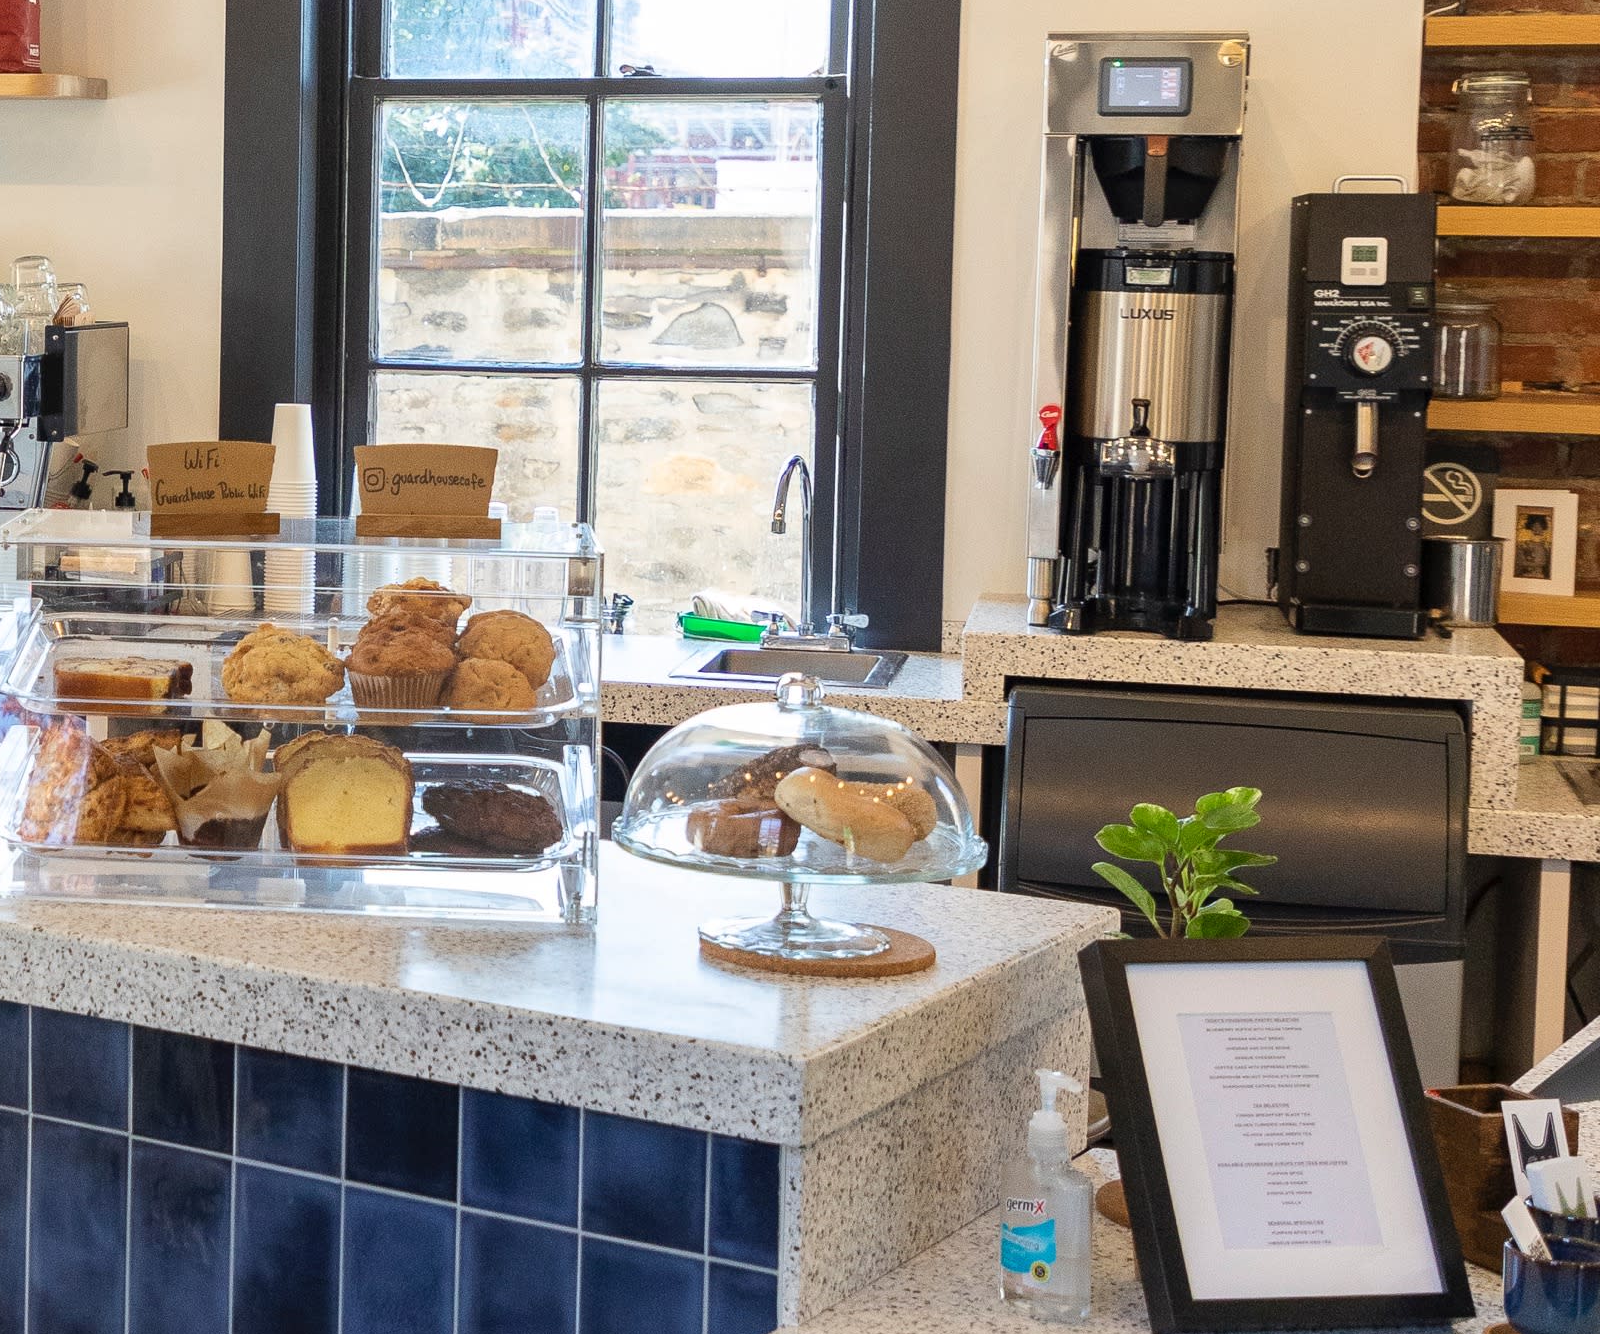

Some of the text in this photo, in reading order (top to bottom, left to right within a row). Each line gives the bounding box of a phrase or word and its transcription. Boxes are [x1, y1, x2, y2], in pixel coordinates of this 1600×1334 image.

[1313, 289, 1340, 298] GH2
[1120, 307, 1175, 321] LUXUS
[155, 479, 215, 506] Guardhouse
